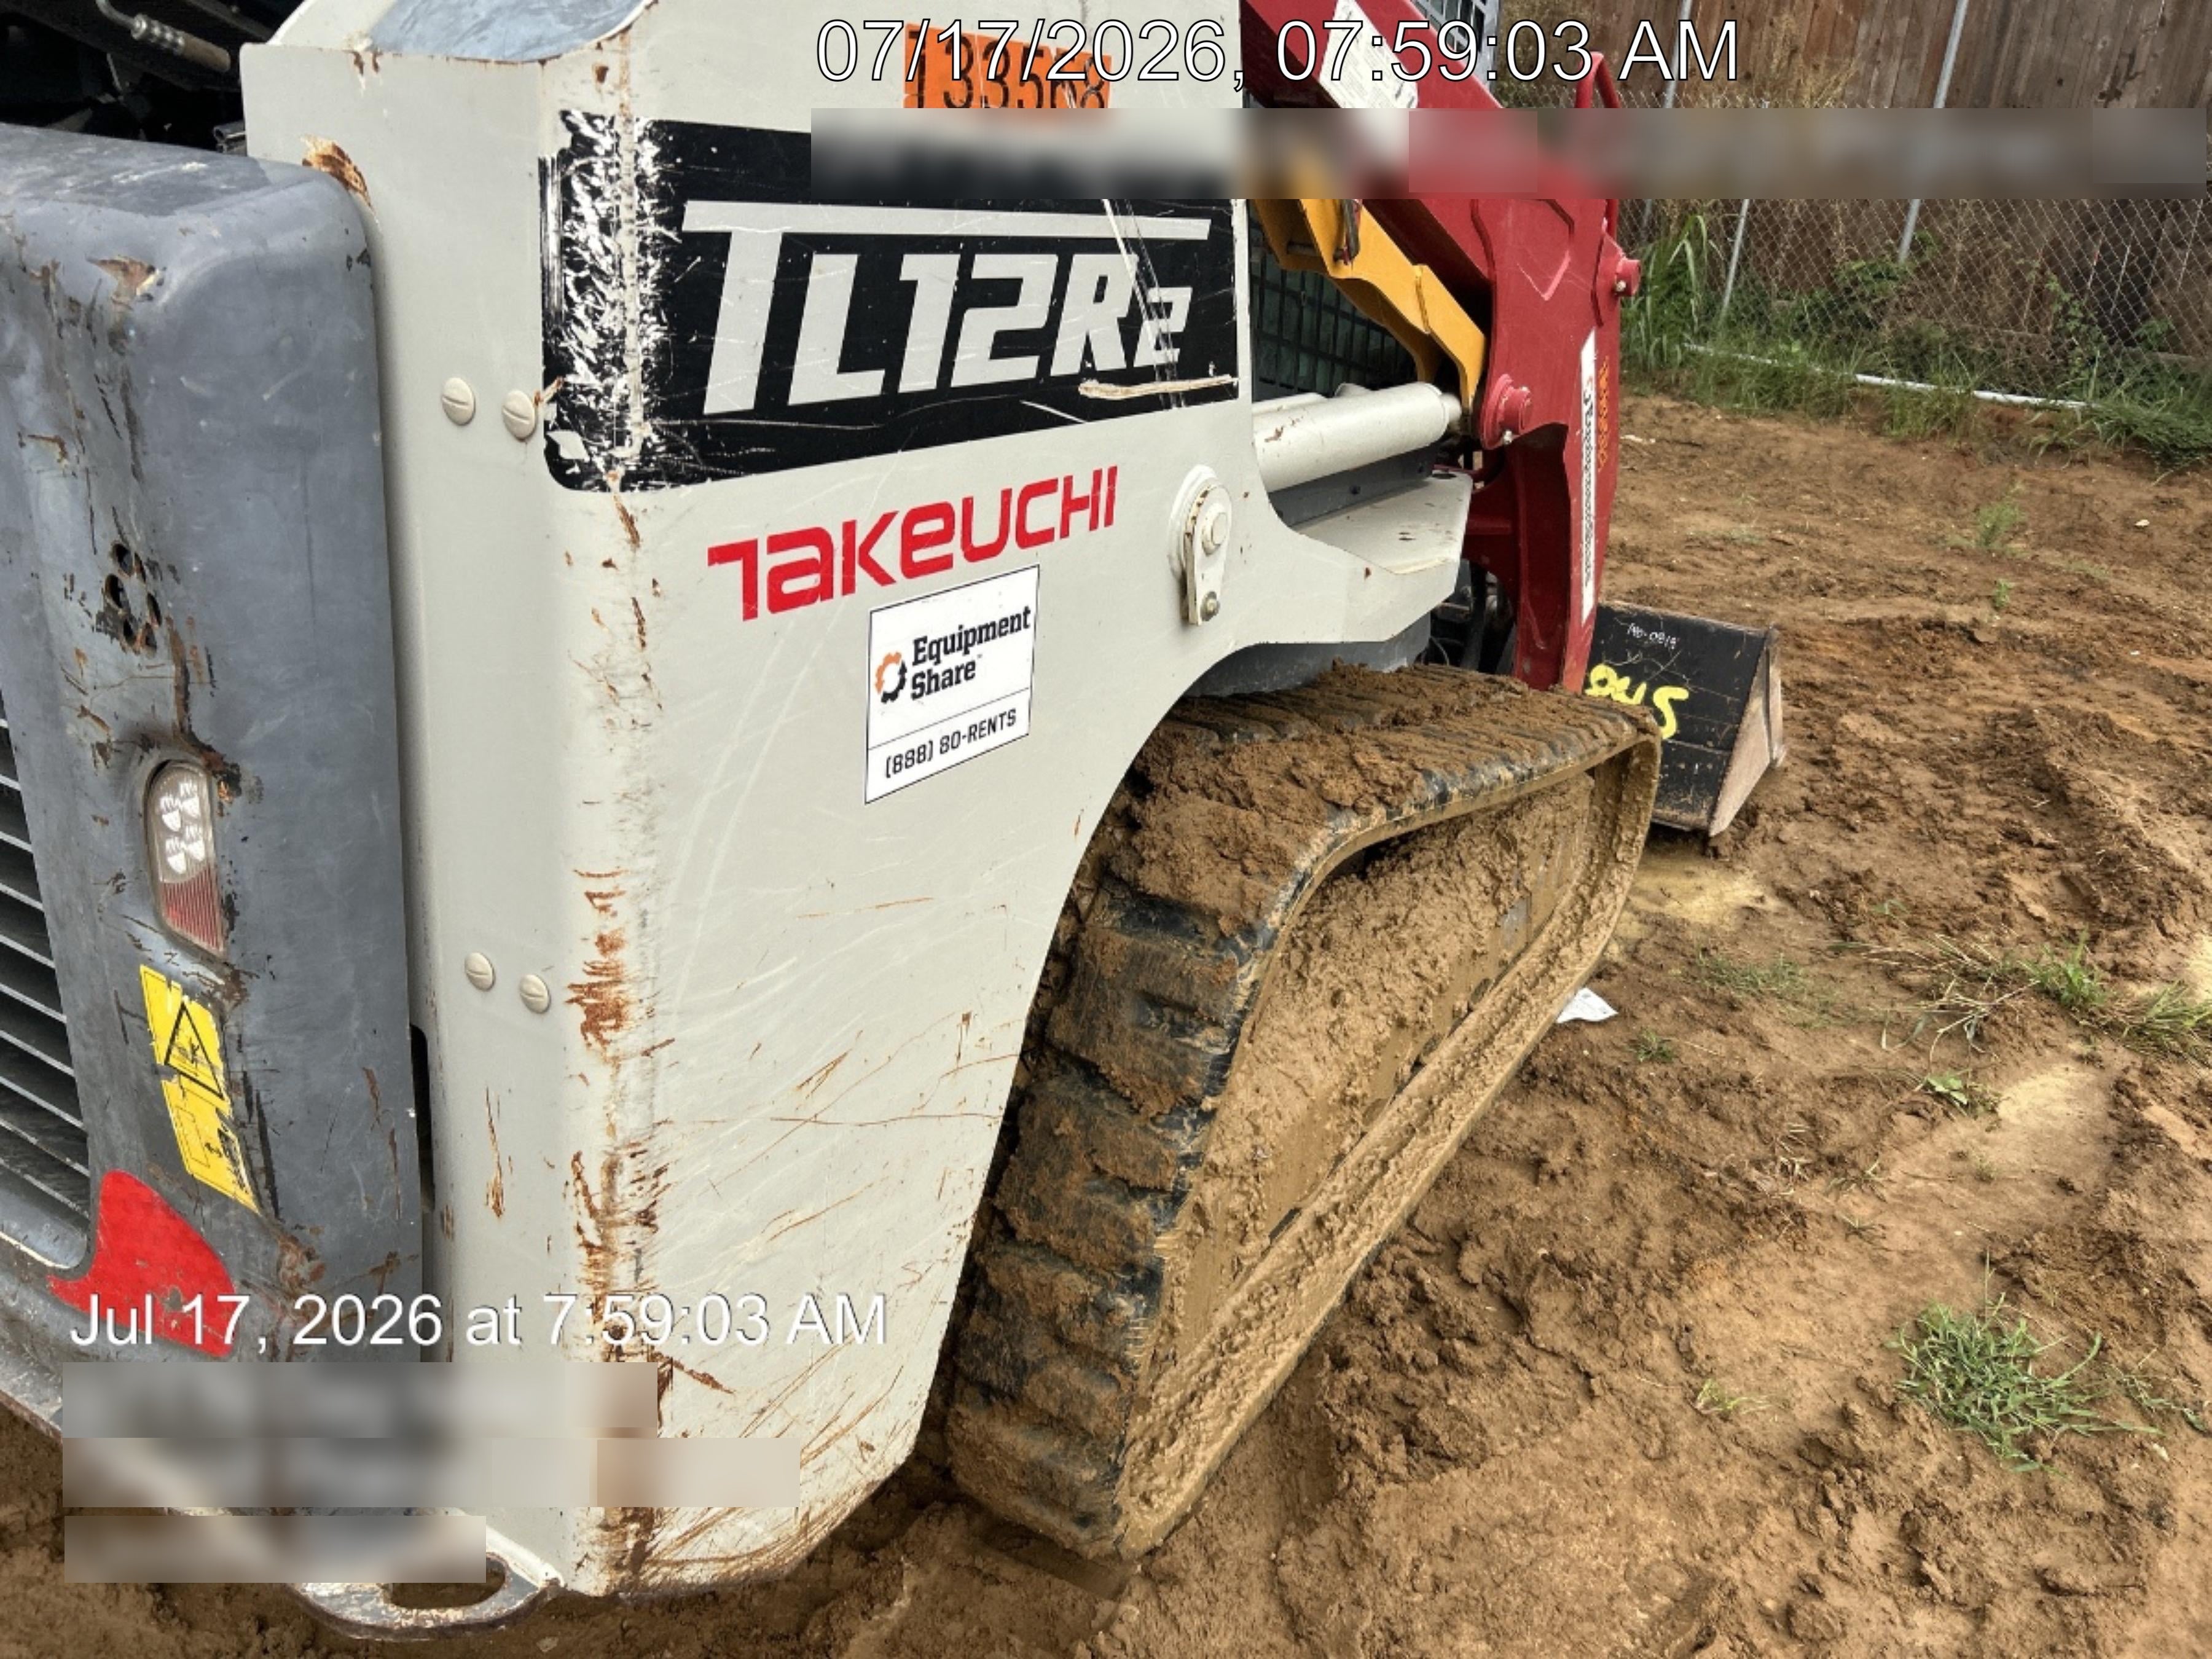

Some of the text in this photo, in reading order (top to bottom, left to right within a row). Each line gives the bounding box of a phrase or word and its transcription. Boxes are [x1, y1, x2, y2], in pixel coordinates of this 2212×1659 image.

[912, 605, 1031, 666] Equipment
[911, 660, 976, 700] Share
[885, 708, 1017, 779] (888) 80-RENTS
